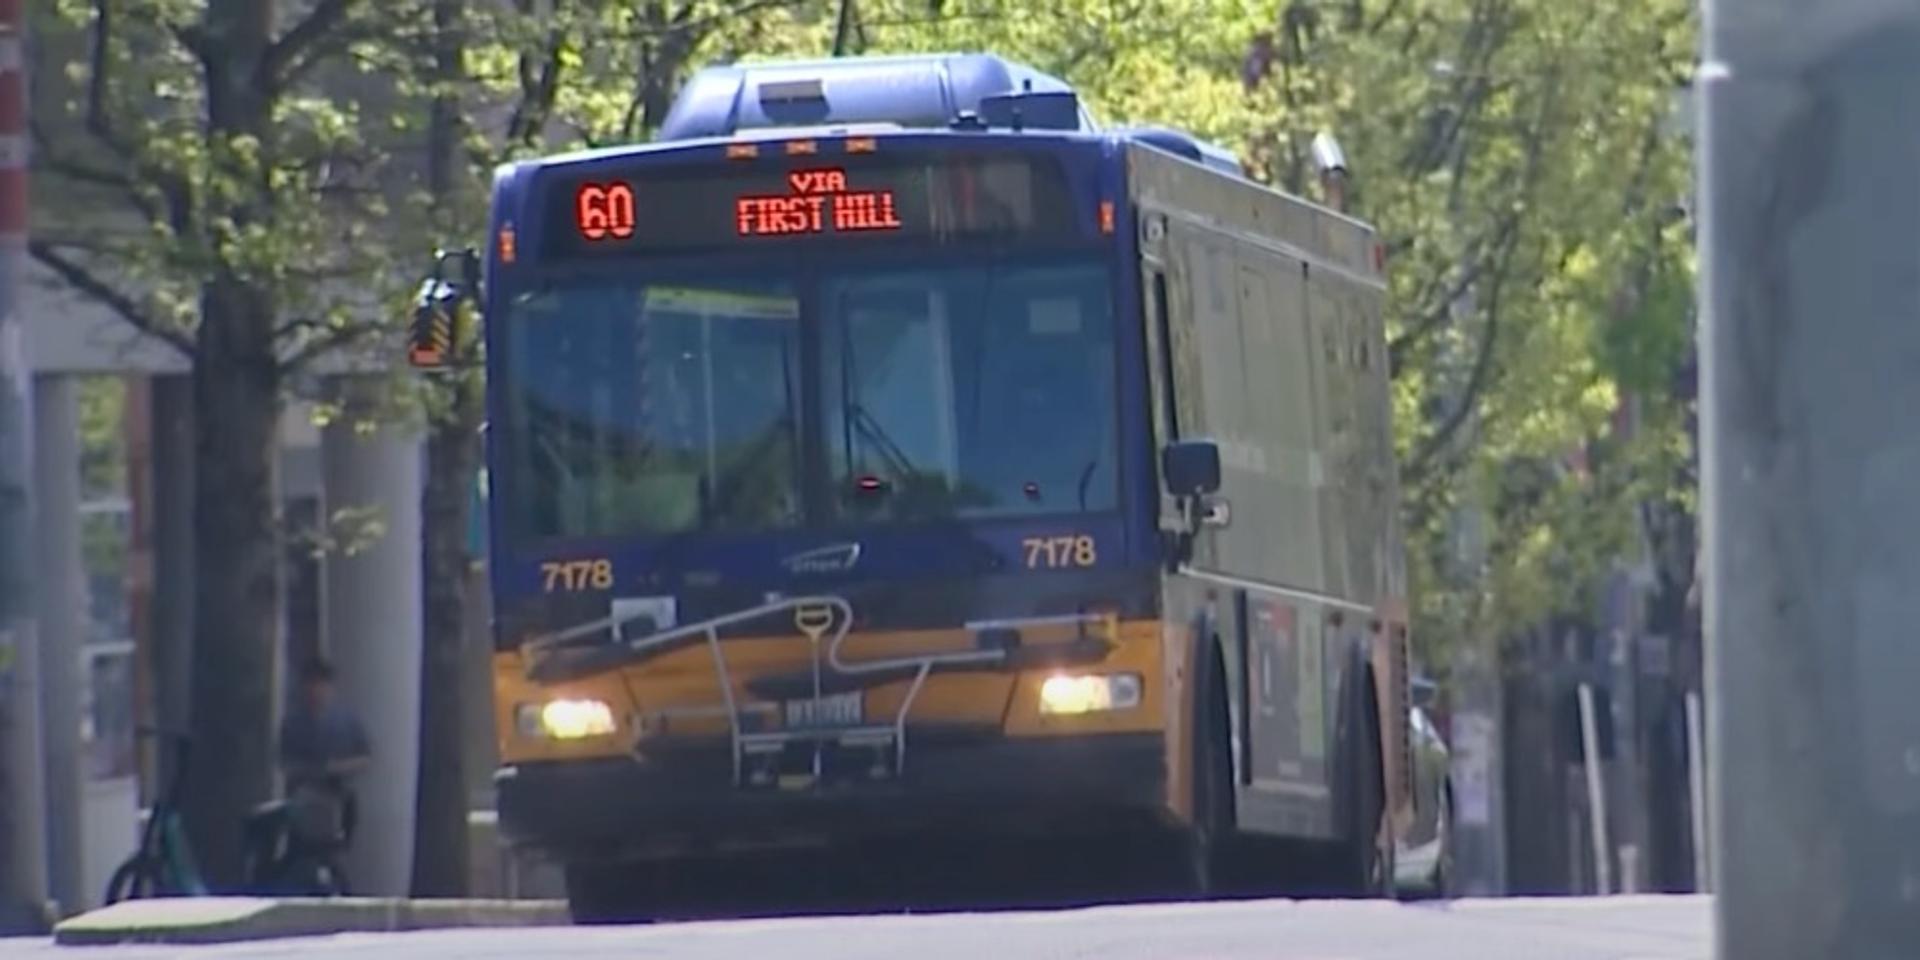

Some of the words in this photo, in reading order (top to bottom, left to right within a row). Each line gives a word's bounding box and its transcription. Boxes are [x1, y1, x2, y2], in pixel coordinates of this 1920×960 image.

[789, 171, 846, 192] VIA
[579, 185, 635, 238] 60
[737, 196, 824, 233] FIRST
[834, 193, 901, 229] HILL
[1023, 535, 1096, 568] 7178
[541, 558, 614, 591] 7178
